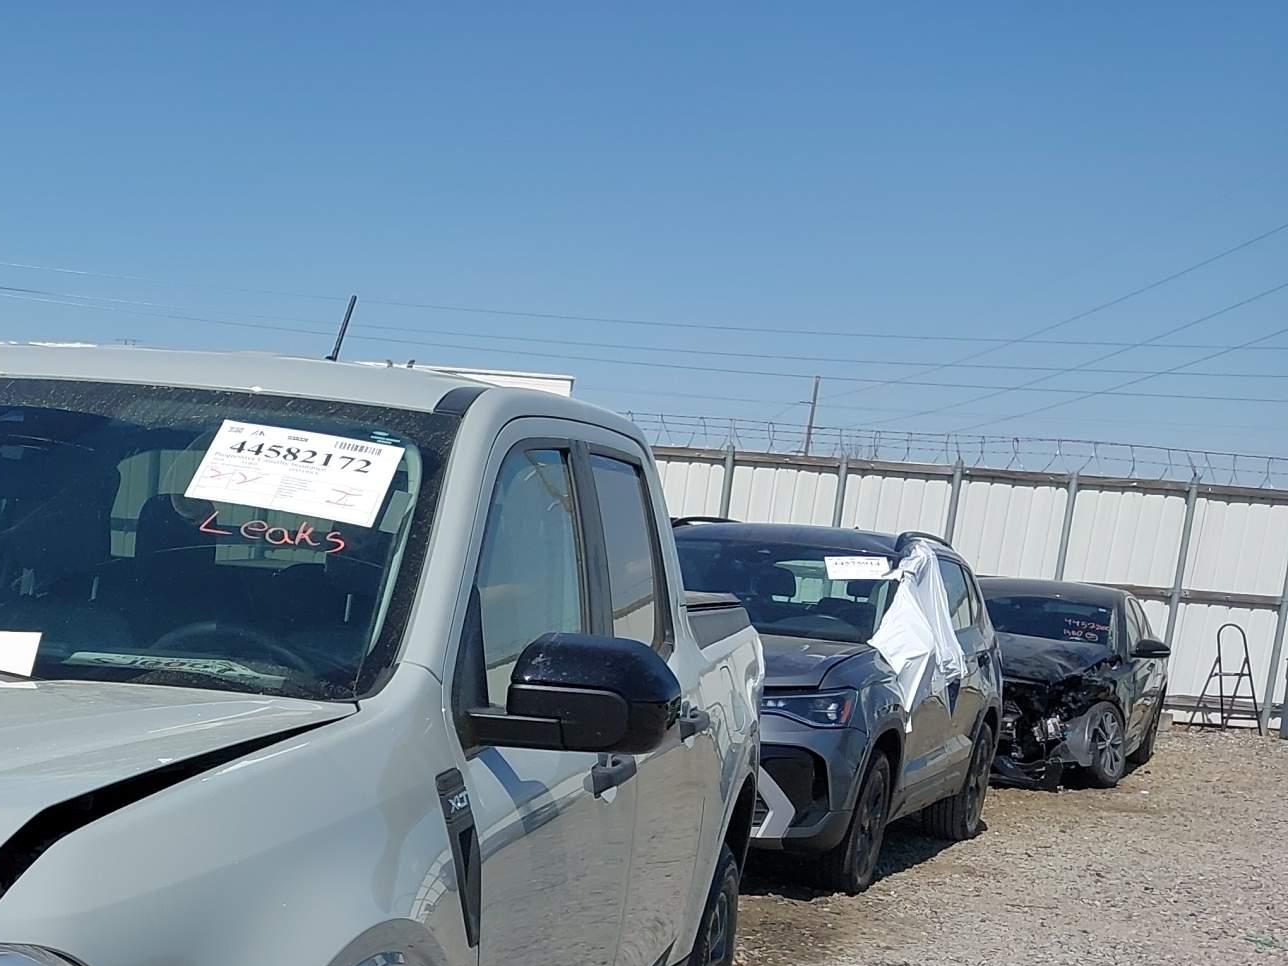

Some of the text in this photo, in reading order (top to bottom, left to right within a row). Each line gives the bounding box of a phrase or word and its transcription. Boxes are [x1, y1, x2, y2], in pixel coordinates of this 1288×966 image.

[229, 440, 372, 474] 44582172
[199, 510, 345, 553] Leaks
[448, 791, 469, 814] XLT
